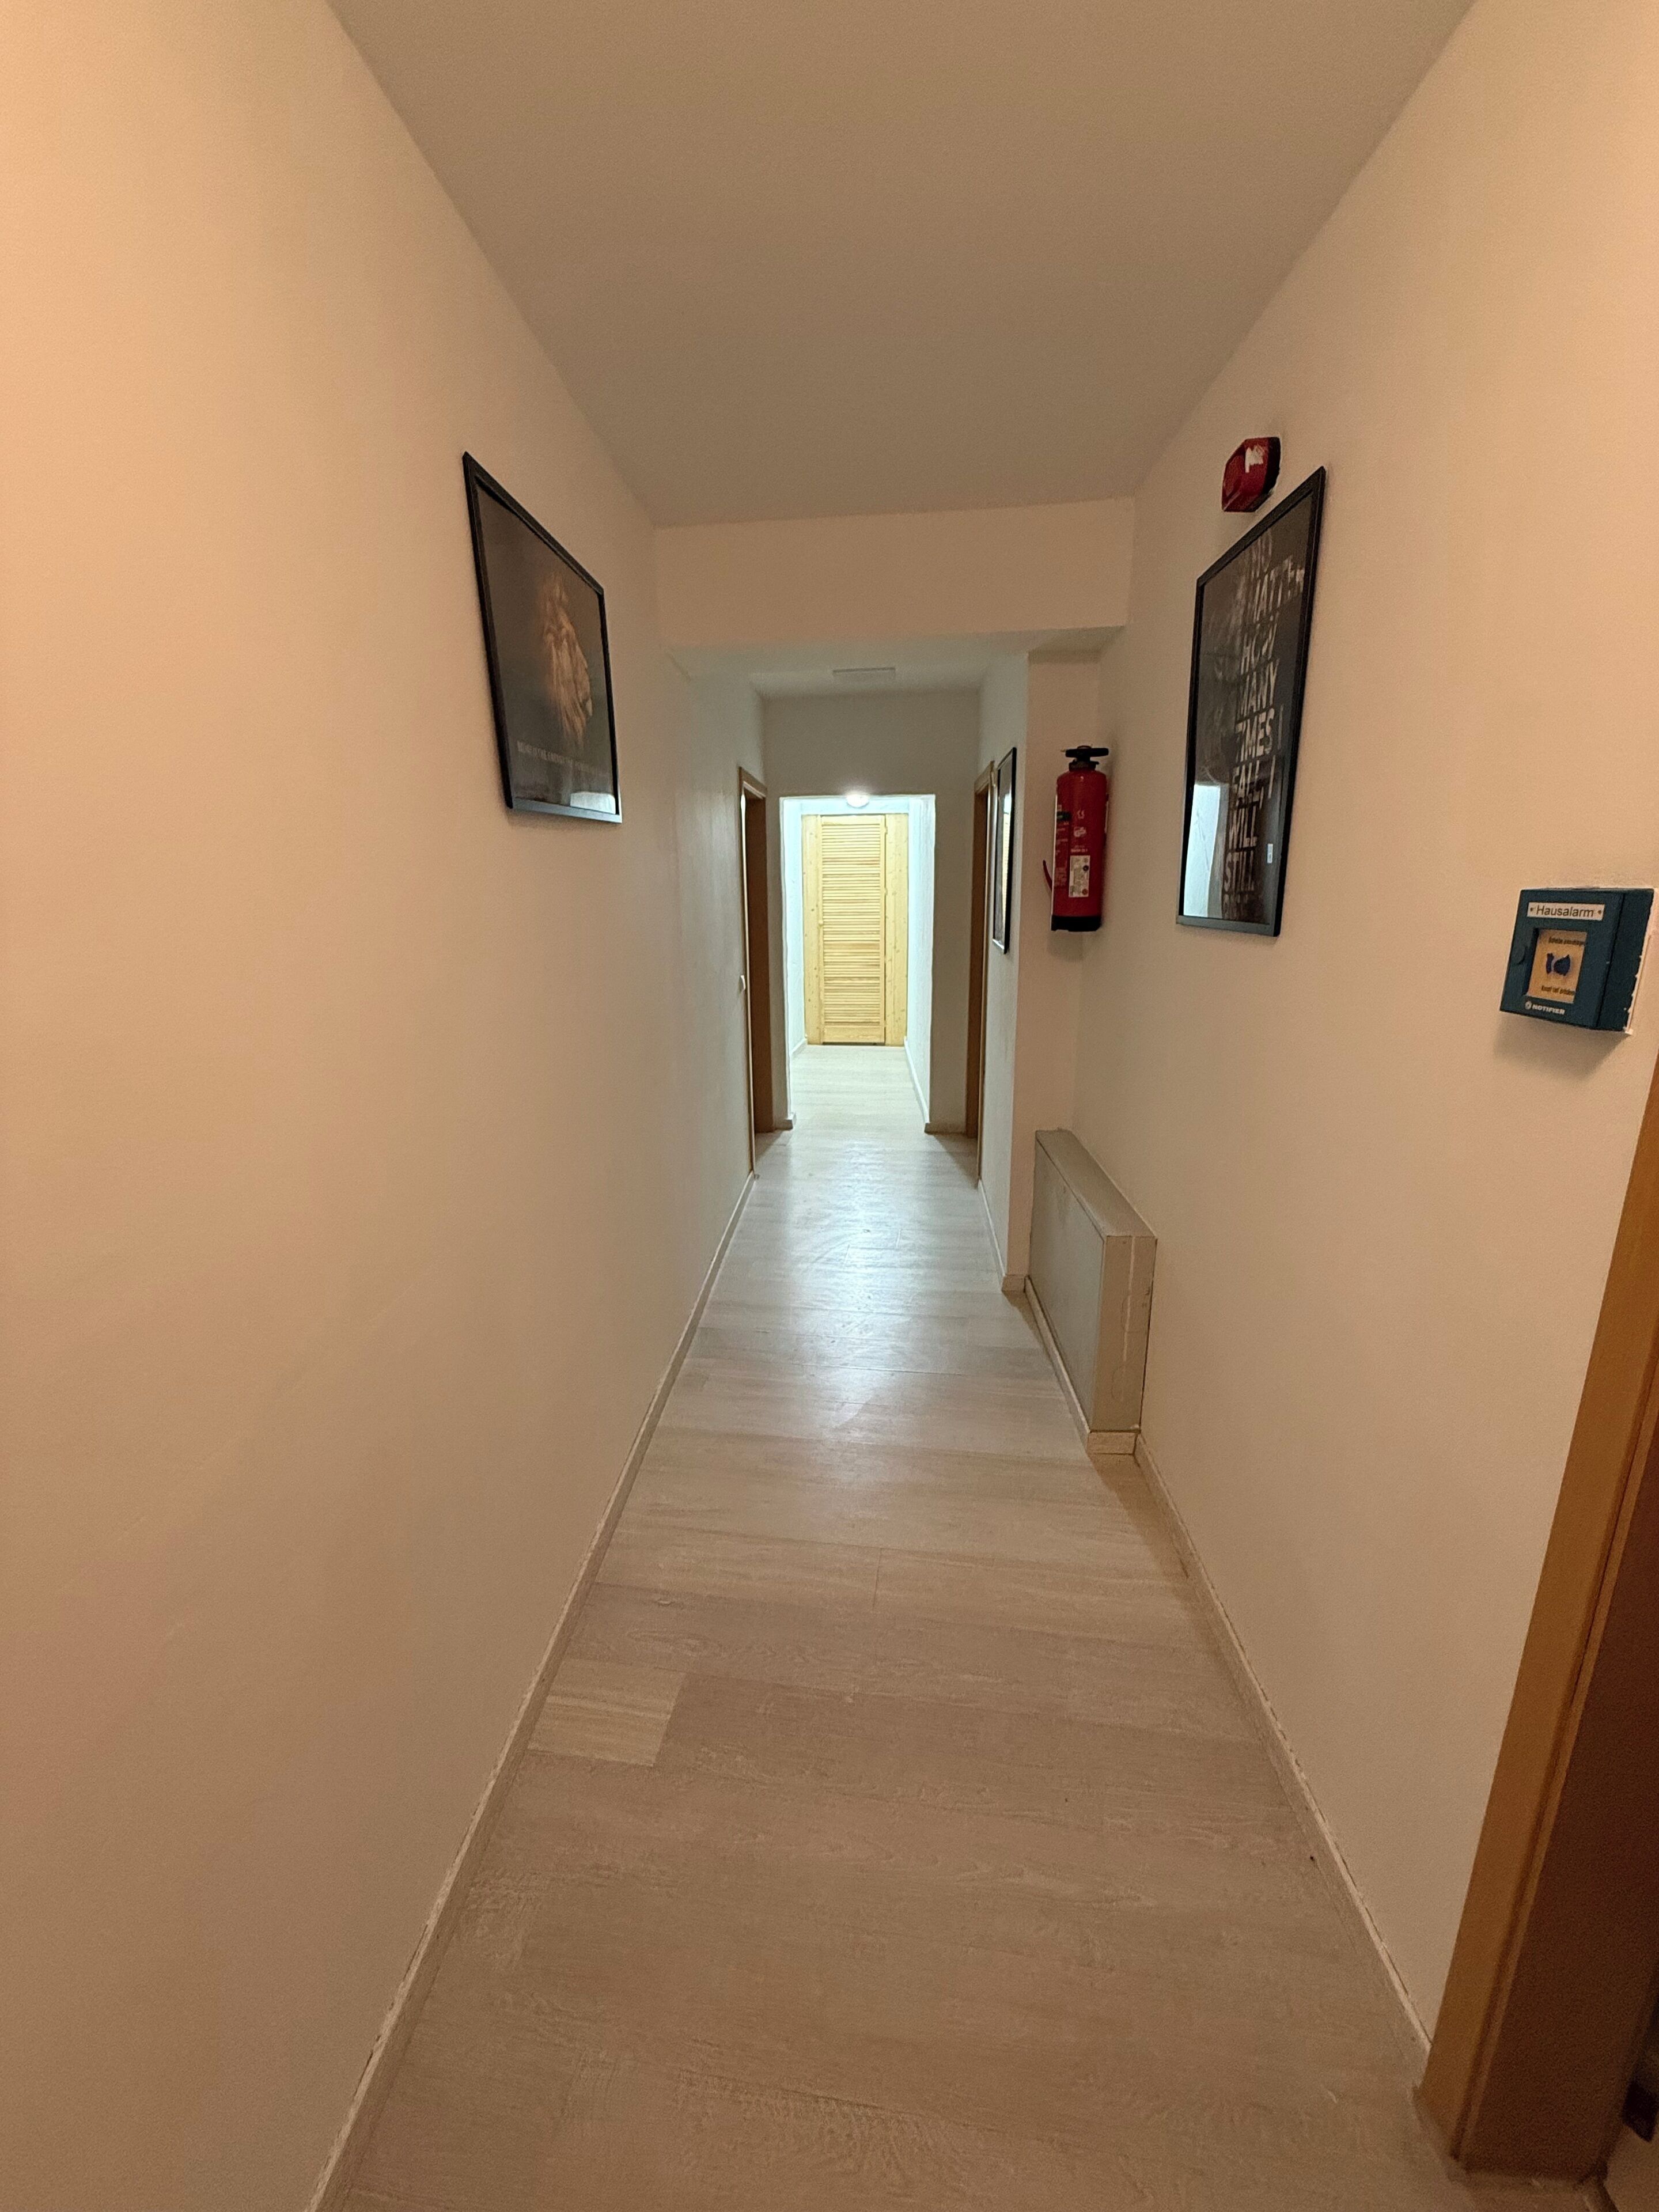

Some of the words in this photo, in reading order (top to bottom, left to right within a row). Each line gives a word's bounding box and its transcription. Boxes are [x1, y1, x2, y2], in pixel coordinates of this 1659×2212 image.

[1236, 658, 1279, 718] MANY
[1234, 707, 1275, 763] TIMES
[1268, 754, 1276, 800] I
[1228, 805, 1259, 849] WILL
[1224, 850, 1256, 892] STILL
[1535, 903, 1594, 918] Hausalarm
[1532, 1003, 1565, 1015] NOTIFIER
